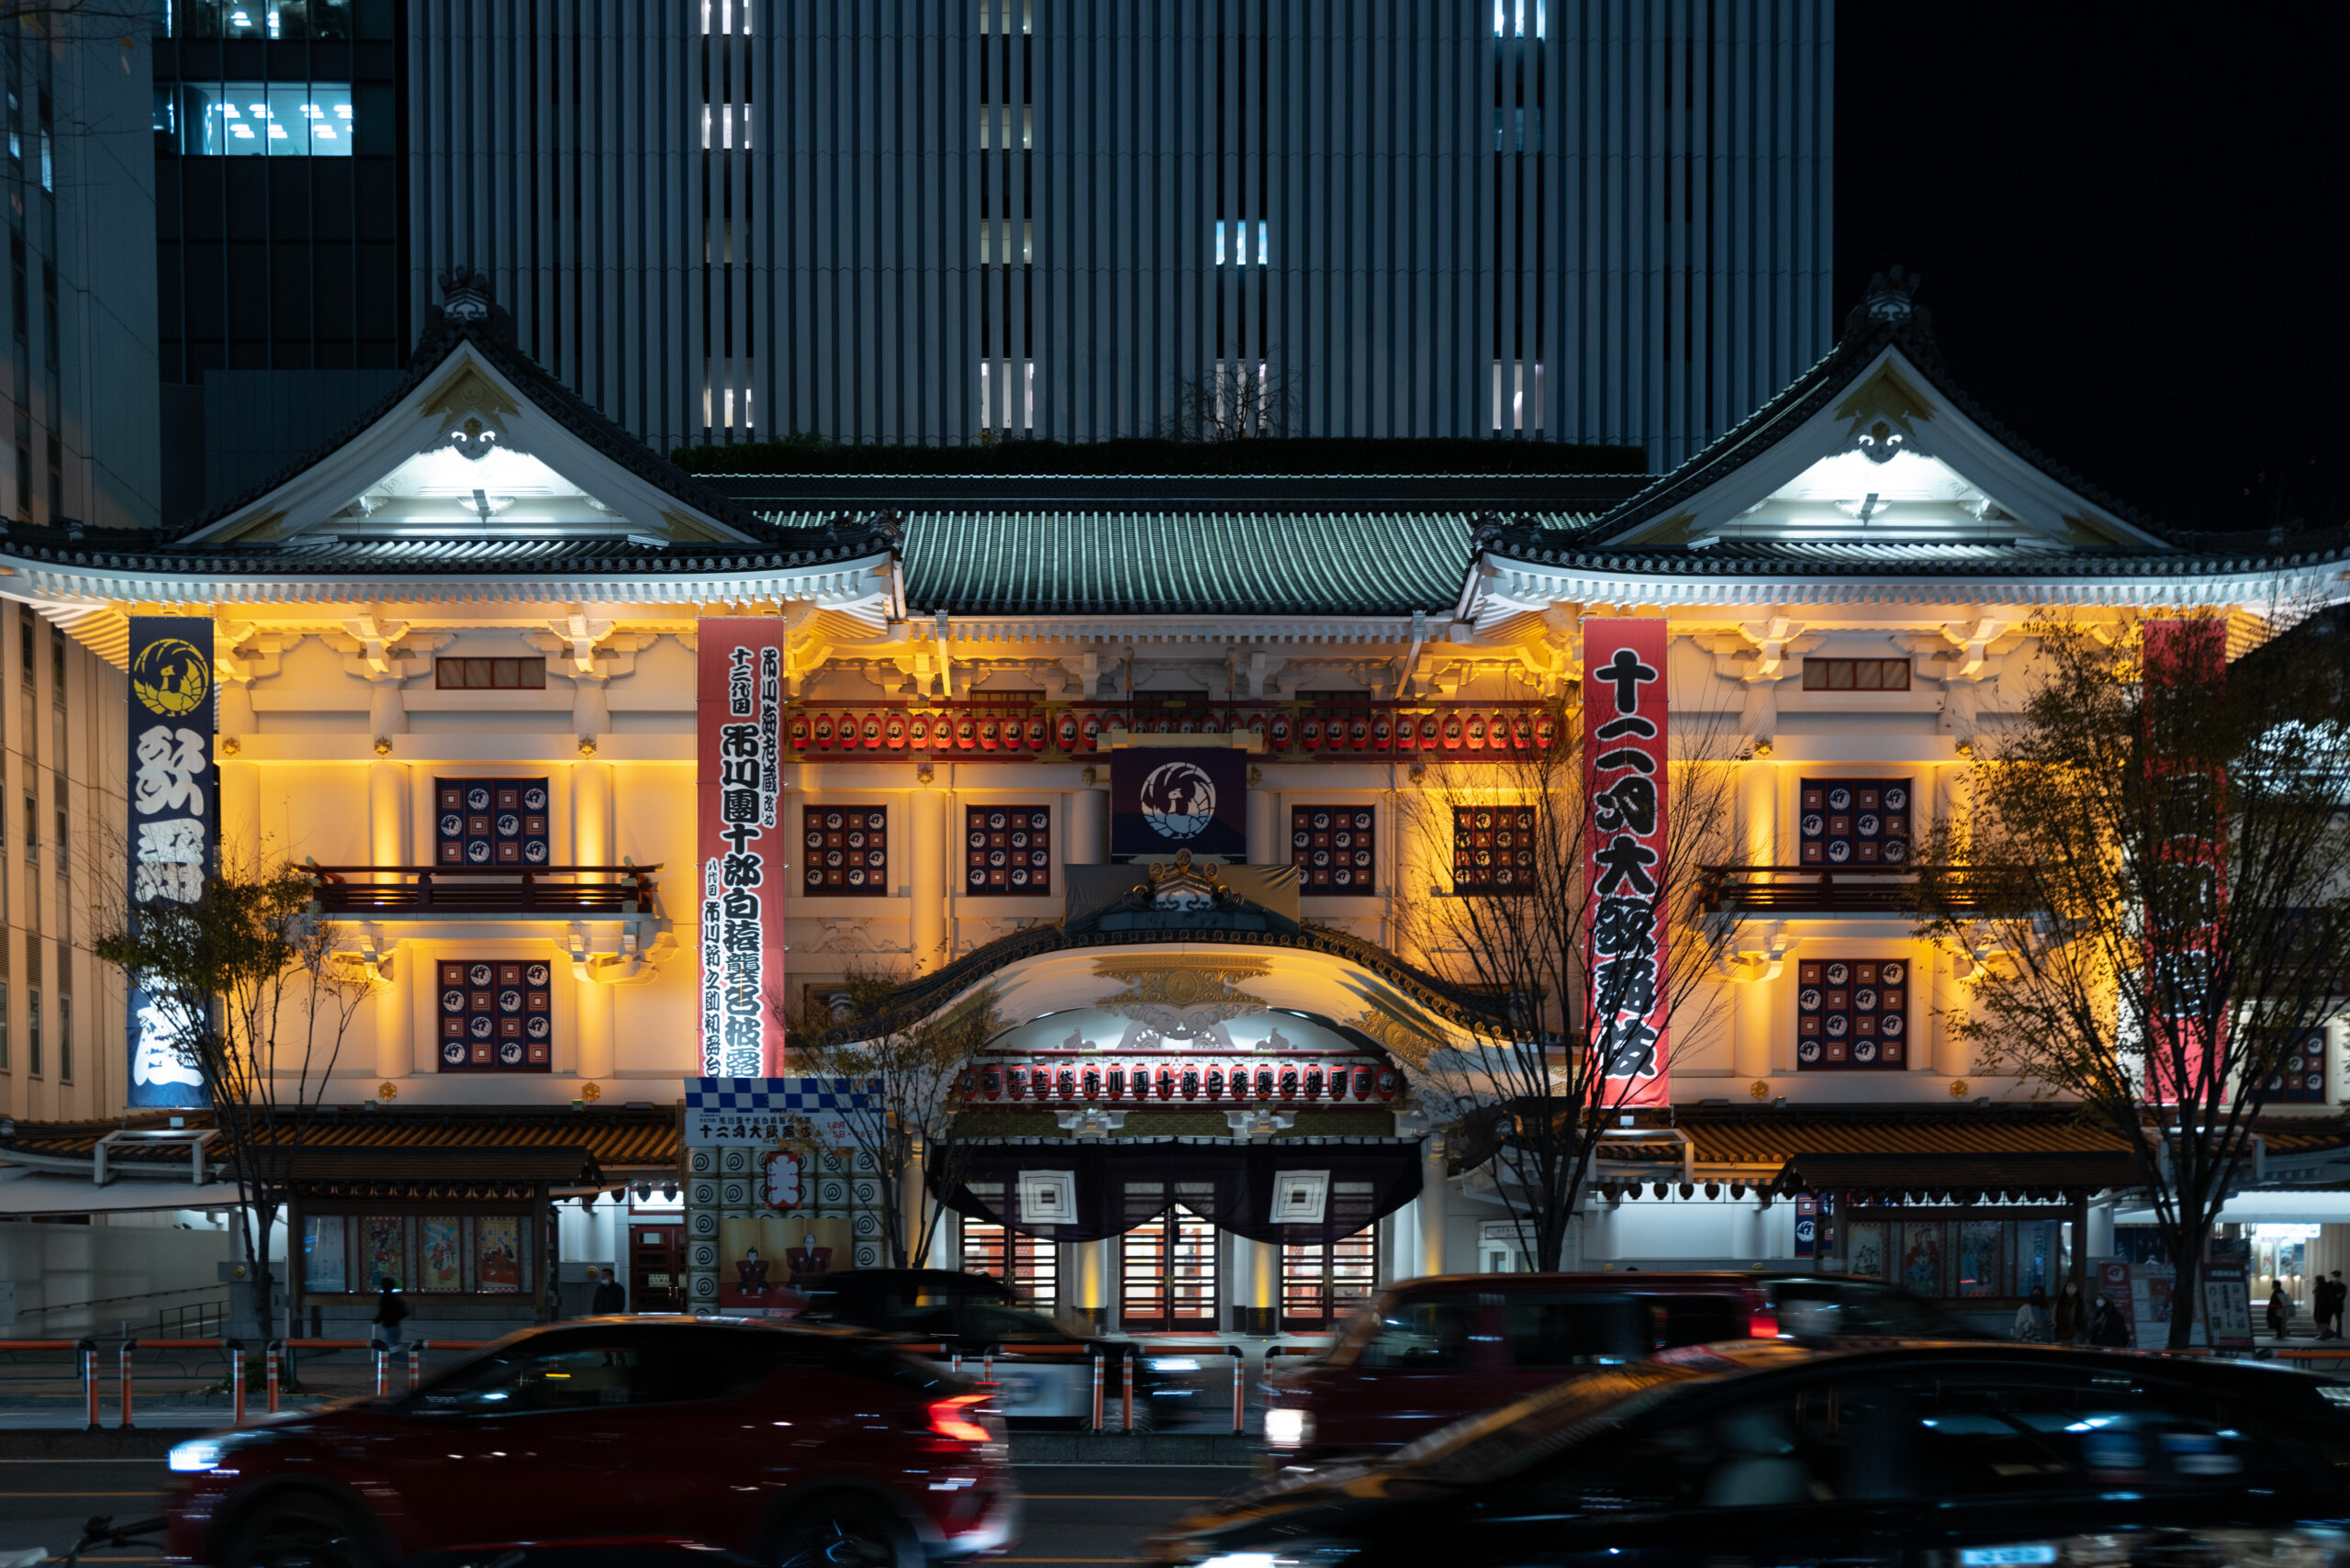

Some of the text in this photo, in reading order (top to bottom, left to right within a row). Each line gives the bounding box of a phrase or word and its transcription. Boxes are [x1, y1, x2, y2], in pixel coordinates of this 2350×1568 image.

[134, 725, 206, 1087] 歌舞座
[1595, 649, 1657, 1078] 十二月大歌舞伎
